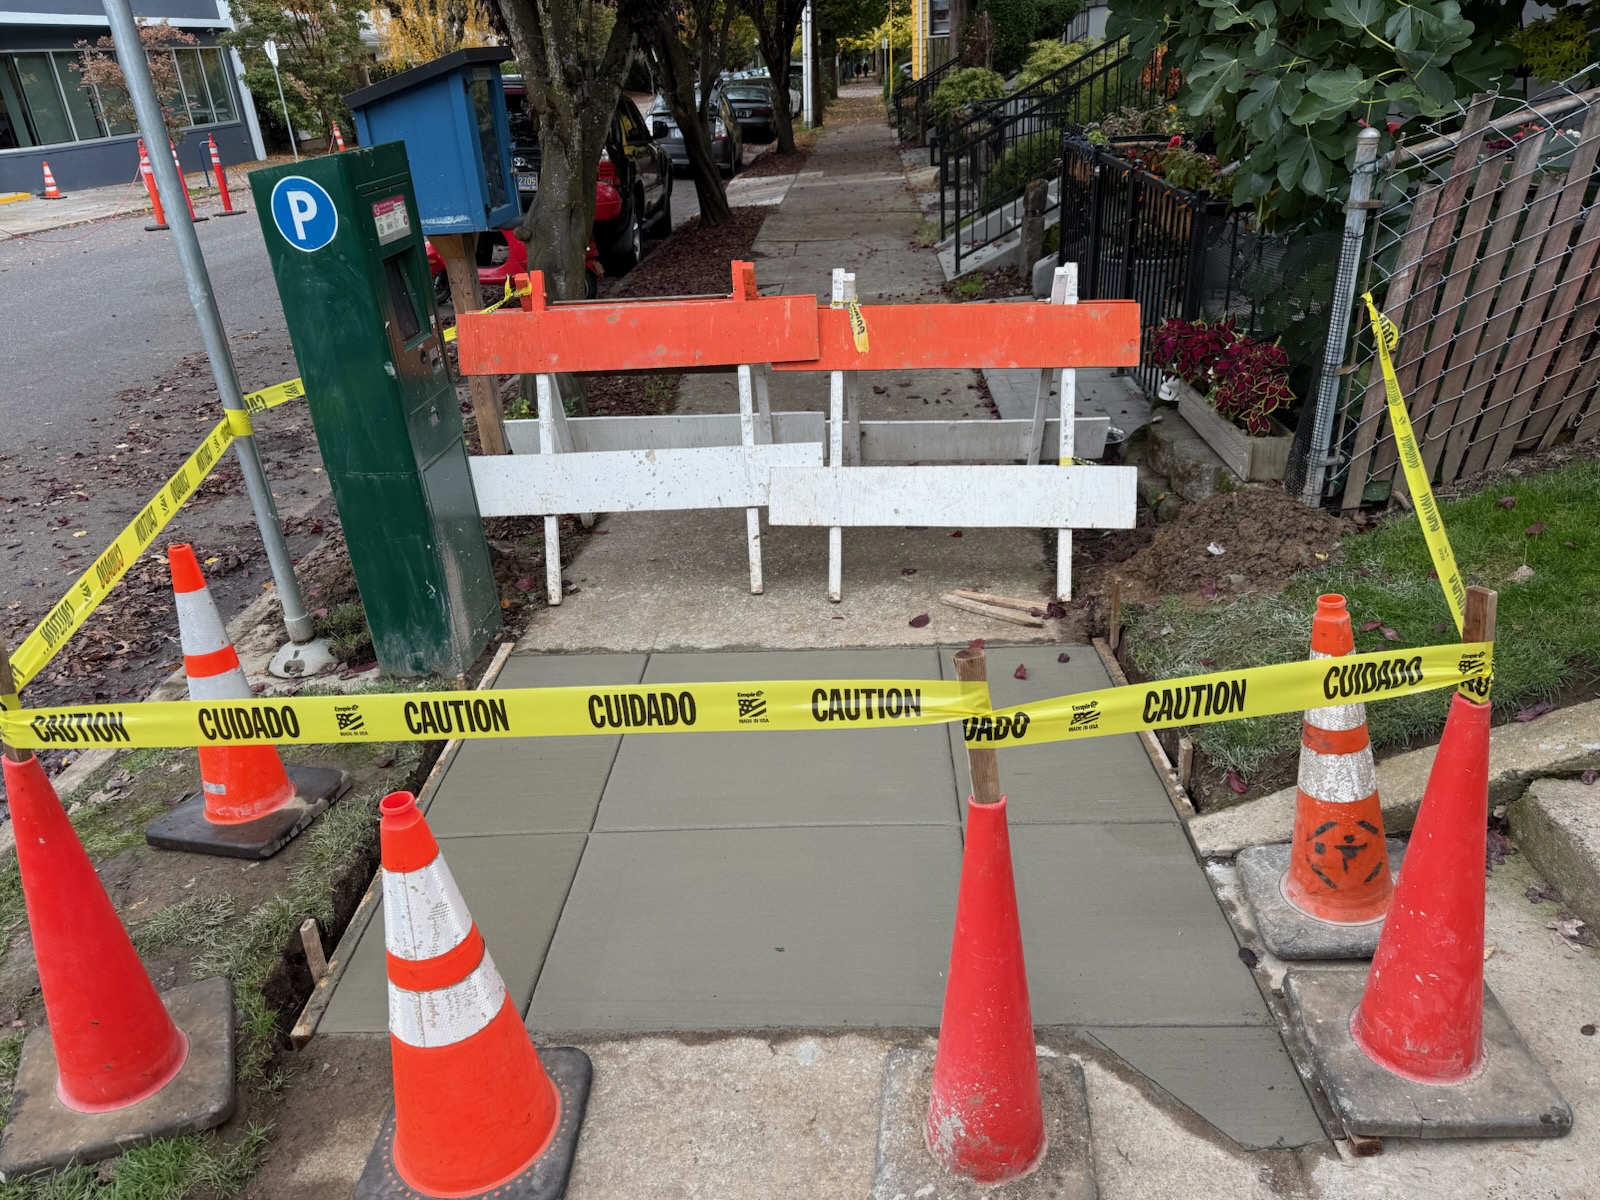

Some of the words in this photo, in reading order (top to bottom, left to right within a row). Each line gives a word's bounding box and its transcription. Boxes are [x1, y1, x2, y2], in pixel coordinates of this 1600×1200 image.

[287, 190, 318, 241] P
[811, 687, 921, 722] CAUTION
[1142, 678, 1247, 724] CAUTION
[1323, 655, 1424, 700] CUIDADO
[30, 711, 131, 742] CAUTION
[198, 705, 300, 741] CUIDADO
[404, 698, 510, 735] CAUTION
[588, 691, 697, 729] CUIDADO
[962, 711, 1031, 742] DADO
